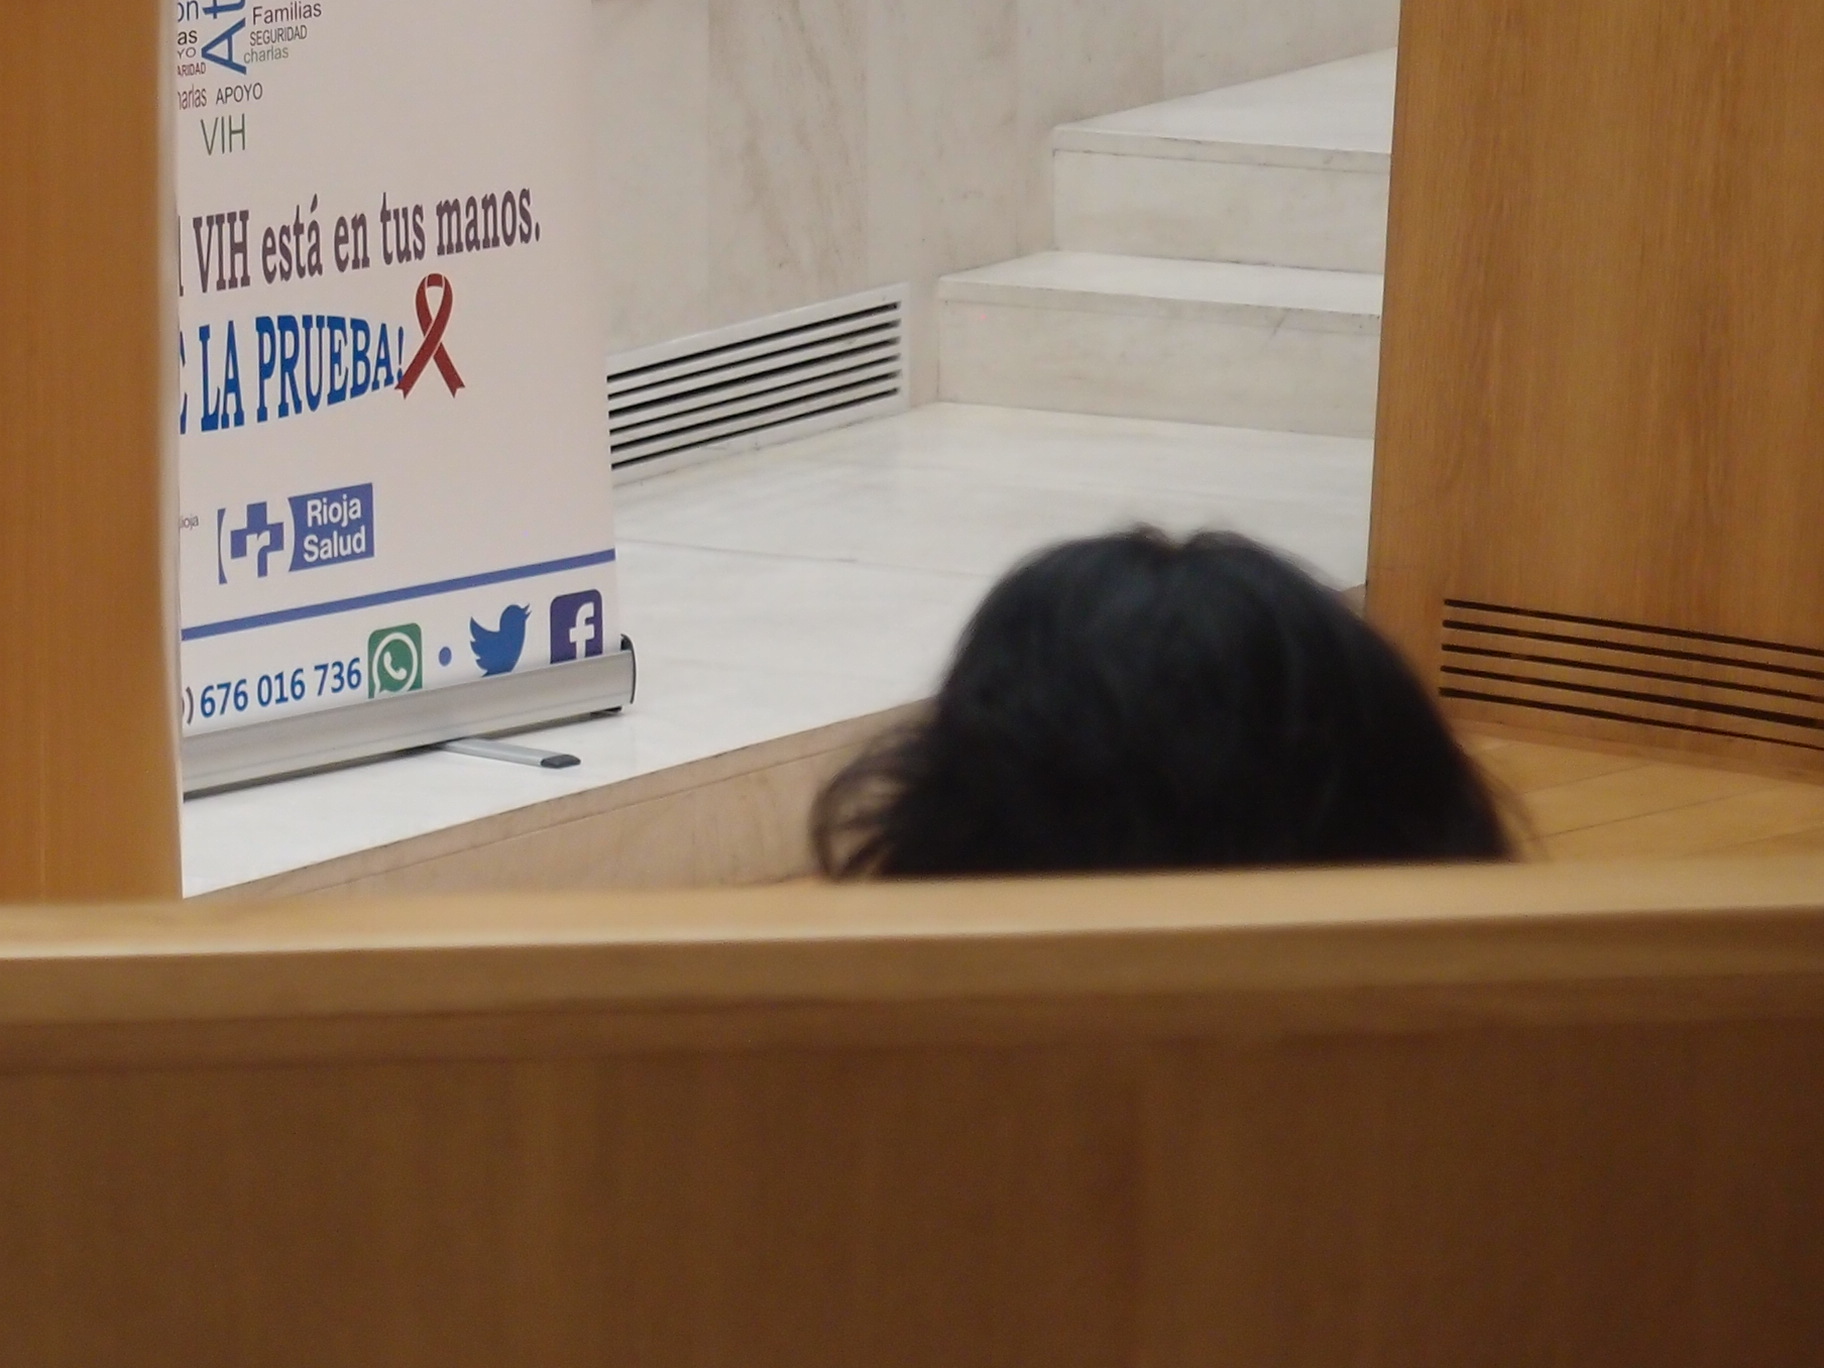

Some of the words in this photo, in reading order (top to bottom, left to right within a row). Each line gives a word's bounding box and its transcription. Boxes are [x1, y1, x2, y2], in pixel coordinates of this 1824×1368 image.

[253, 1, 322, 25] Familias
[250, 25, 307, 46] SEGURIDAD
[244, 46, 289, 64] charlas
[216, 82, 263, 105] APOYO
[201, 113, 245, 156] VIH
[193, 210, 250, 294] VIH
[262, 193, 323, 285] está
[334, 210, 370, 272] en
[380, 191, 426, 266] tus
[436, 188, 540, 257] manos.
[199, 321, 244, 432] LA
[255, 314, 404, 423] PRUEBA!
[306, 495, 361, 528] Rioja
[303, 526, 366, 564] Salud
[200, 678, 248, 718] 676
[257, 668, 305, 708] 016
[314, 658, 362, 696] 736
